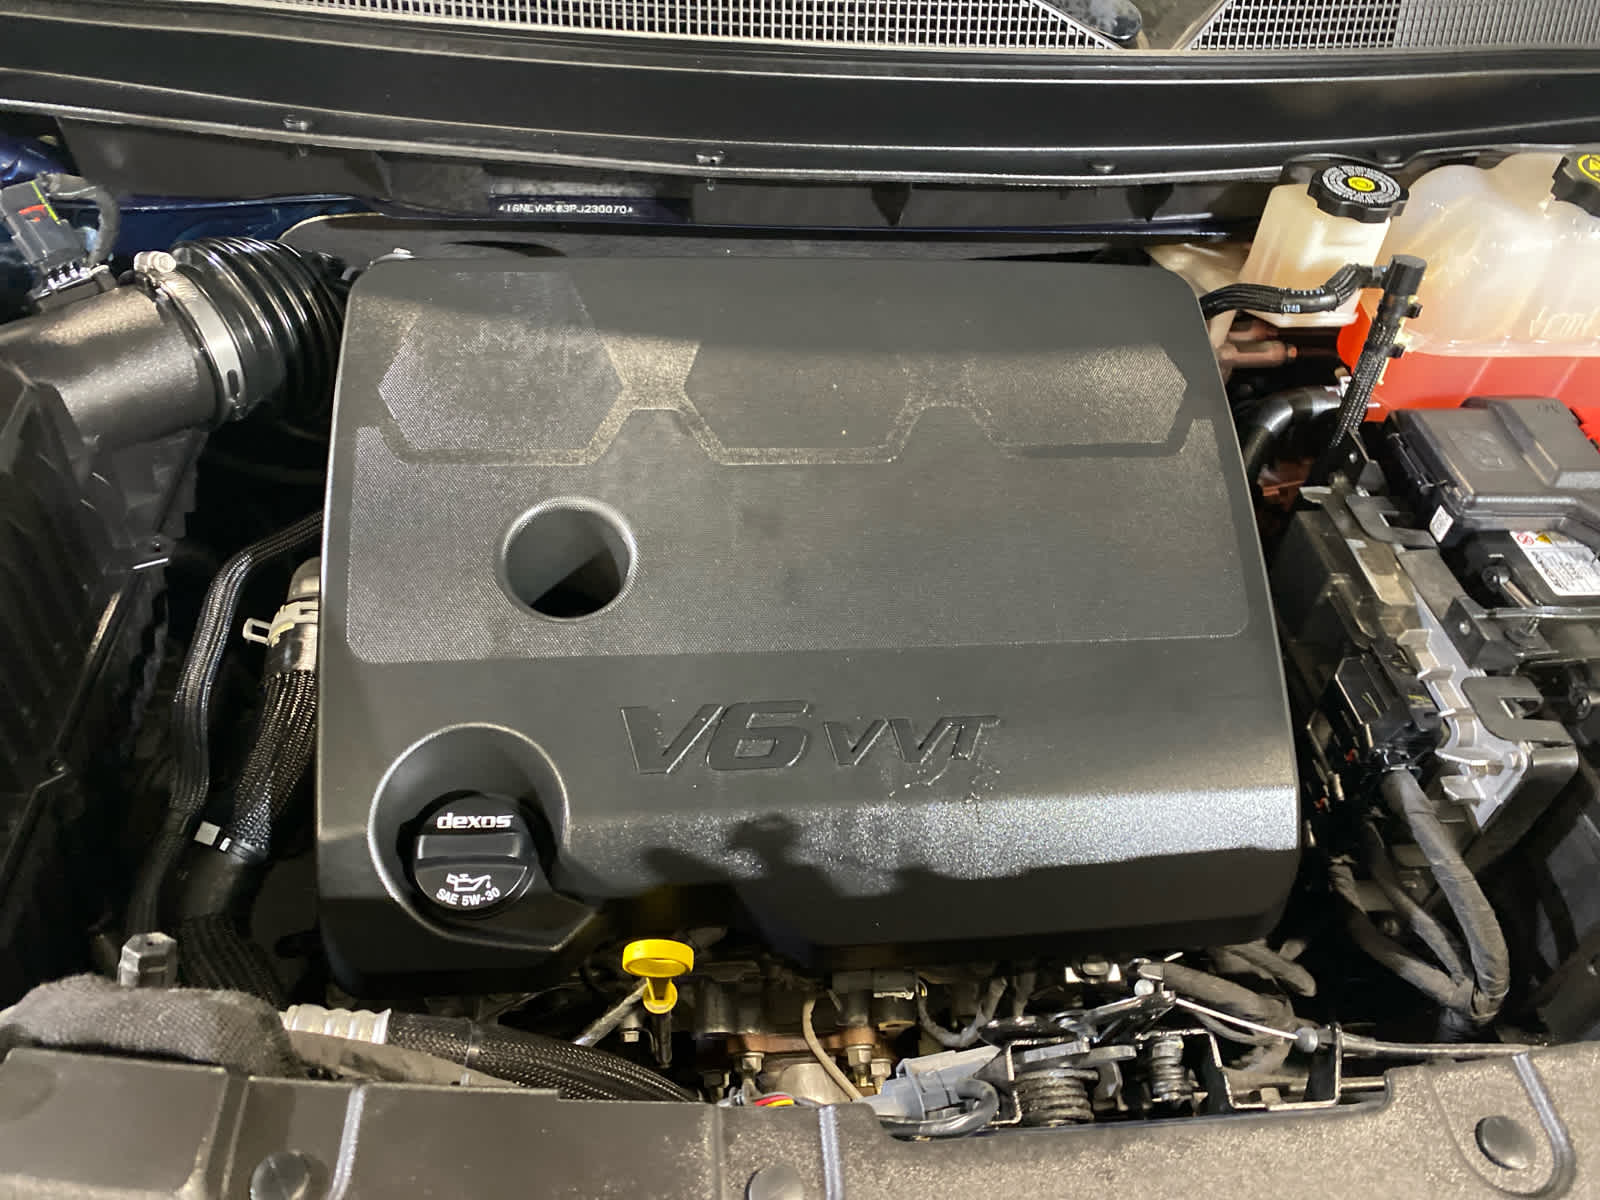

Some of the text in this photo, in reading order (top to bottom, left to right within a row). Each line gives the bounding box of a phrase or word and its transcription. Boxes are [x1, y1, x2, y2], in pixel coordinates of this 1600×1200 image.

[619, 699, 1001, 775] V6 VVT
[436, 812, 514, 829] dexos
[435, 887, 501, 906] SAE 5W-30
